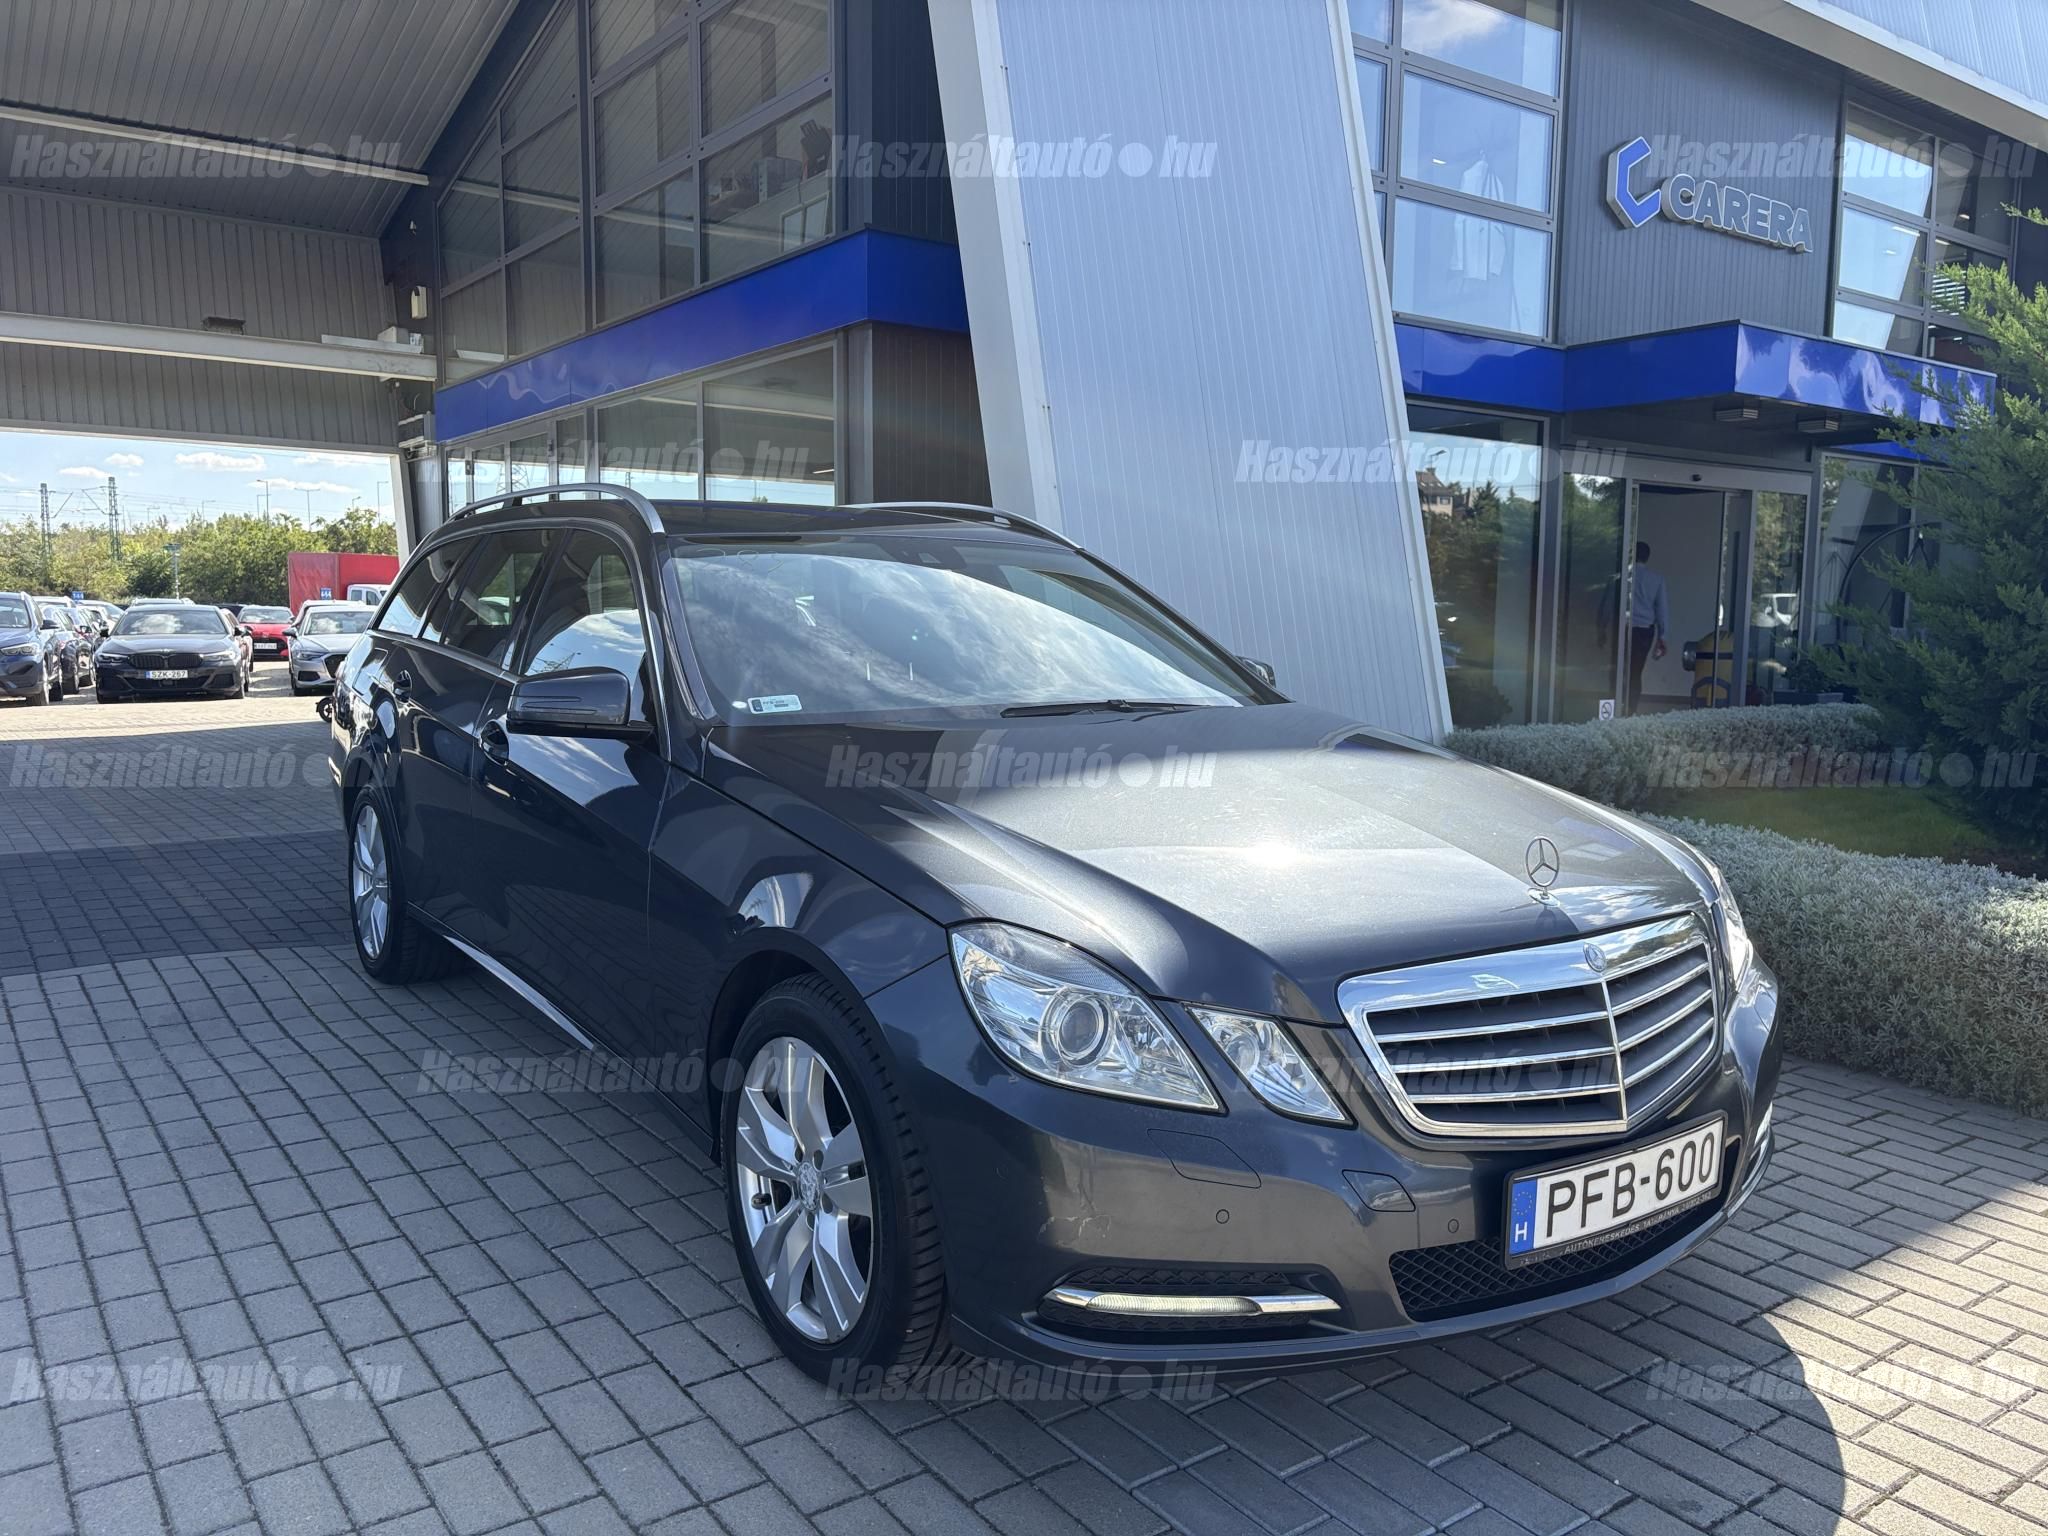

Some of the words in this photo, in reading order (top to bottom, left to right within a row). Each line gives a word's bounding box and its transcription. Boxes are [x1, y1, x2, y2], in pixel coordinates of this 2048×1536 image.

[1664, 174, 1814, 253] CARERA
[1514, 1222, 1528, 1243] H
[1546, 1132, 1715, 1238] PFB-600
